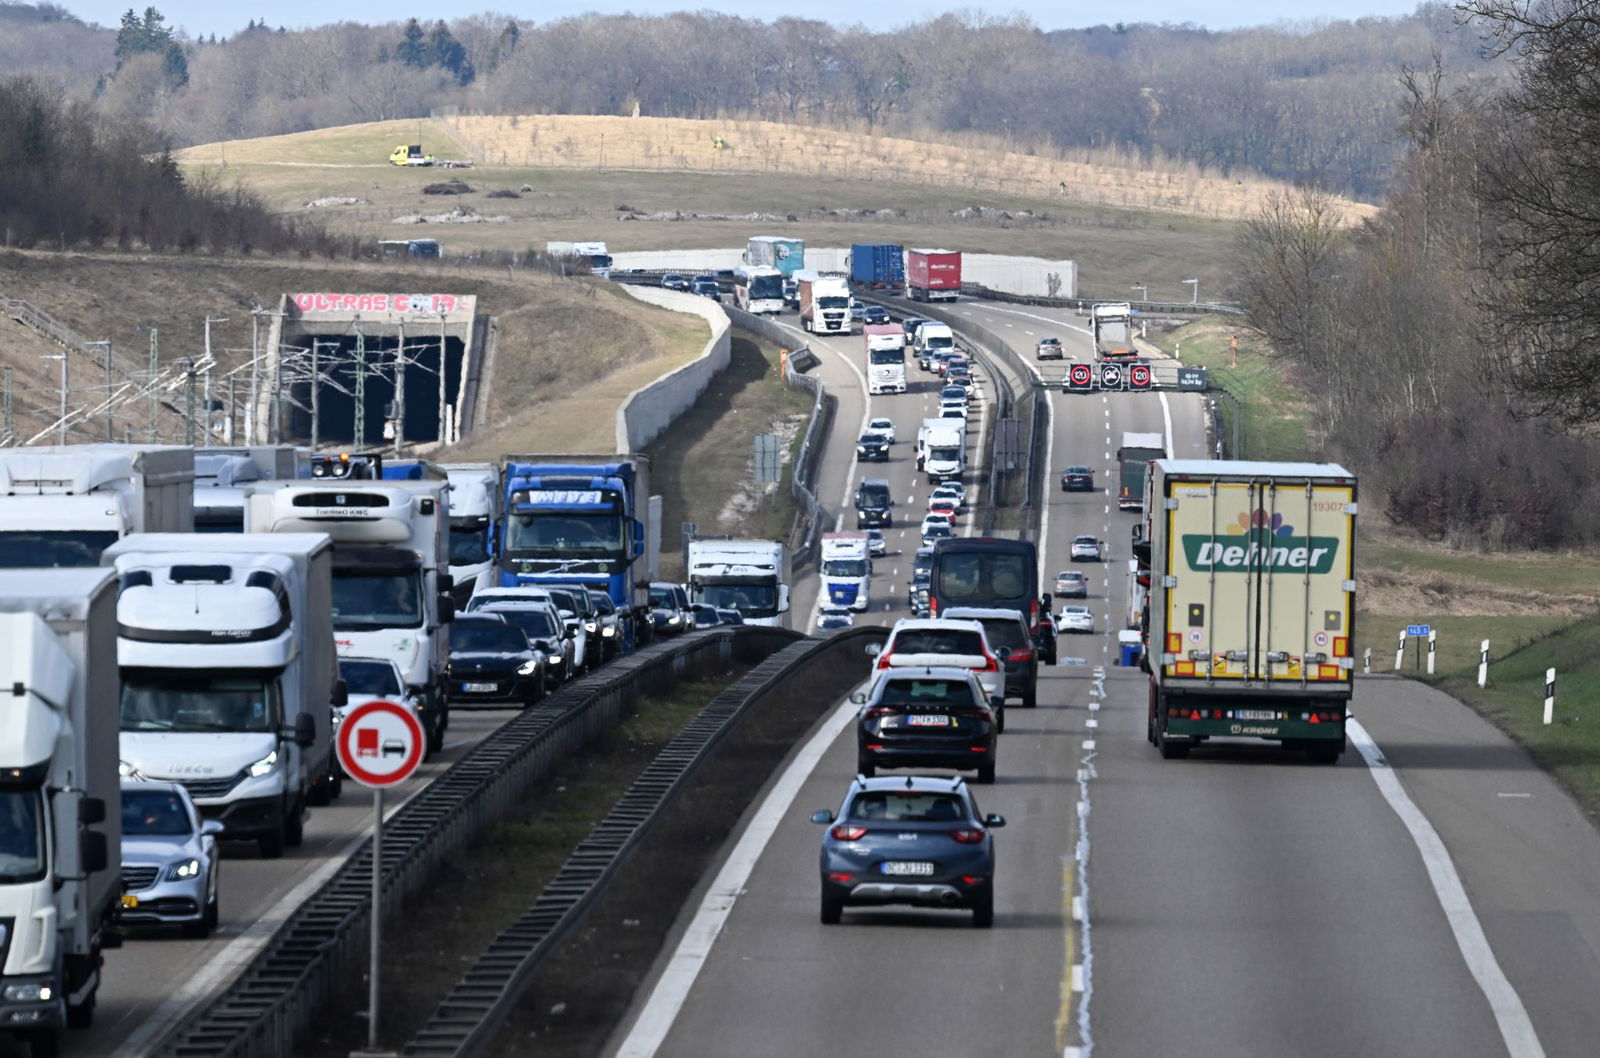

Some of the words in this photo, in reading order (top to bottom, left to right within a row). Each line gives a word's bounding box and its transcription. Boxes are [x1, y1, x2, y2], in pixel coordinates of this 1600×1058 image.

[295, 293, 389, 312] ULTRAS
[1074, 371, 1087, 380] 120
[1134, 371, 1147, 380] 120
[1312, 502, 1344, 512] 19307
[1195, 542, 1328, 567] Dehner
[1242, 727, 1280, 735] KRONE
